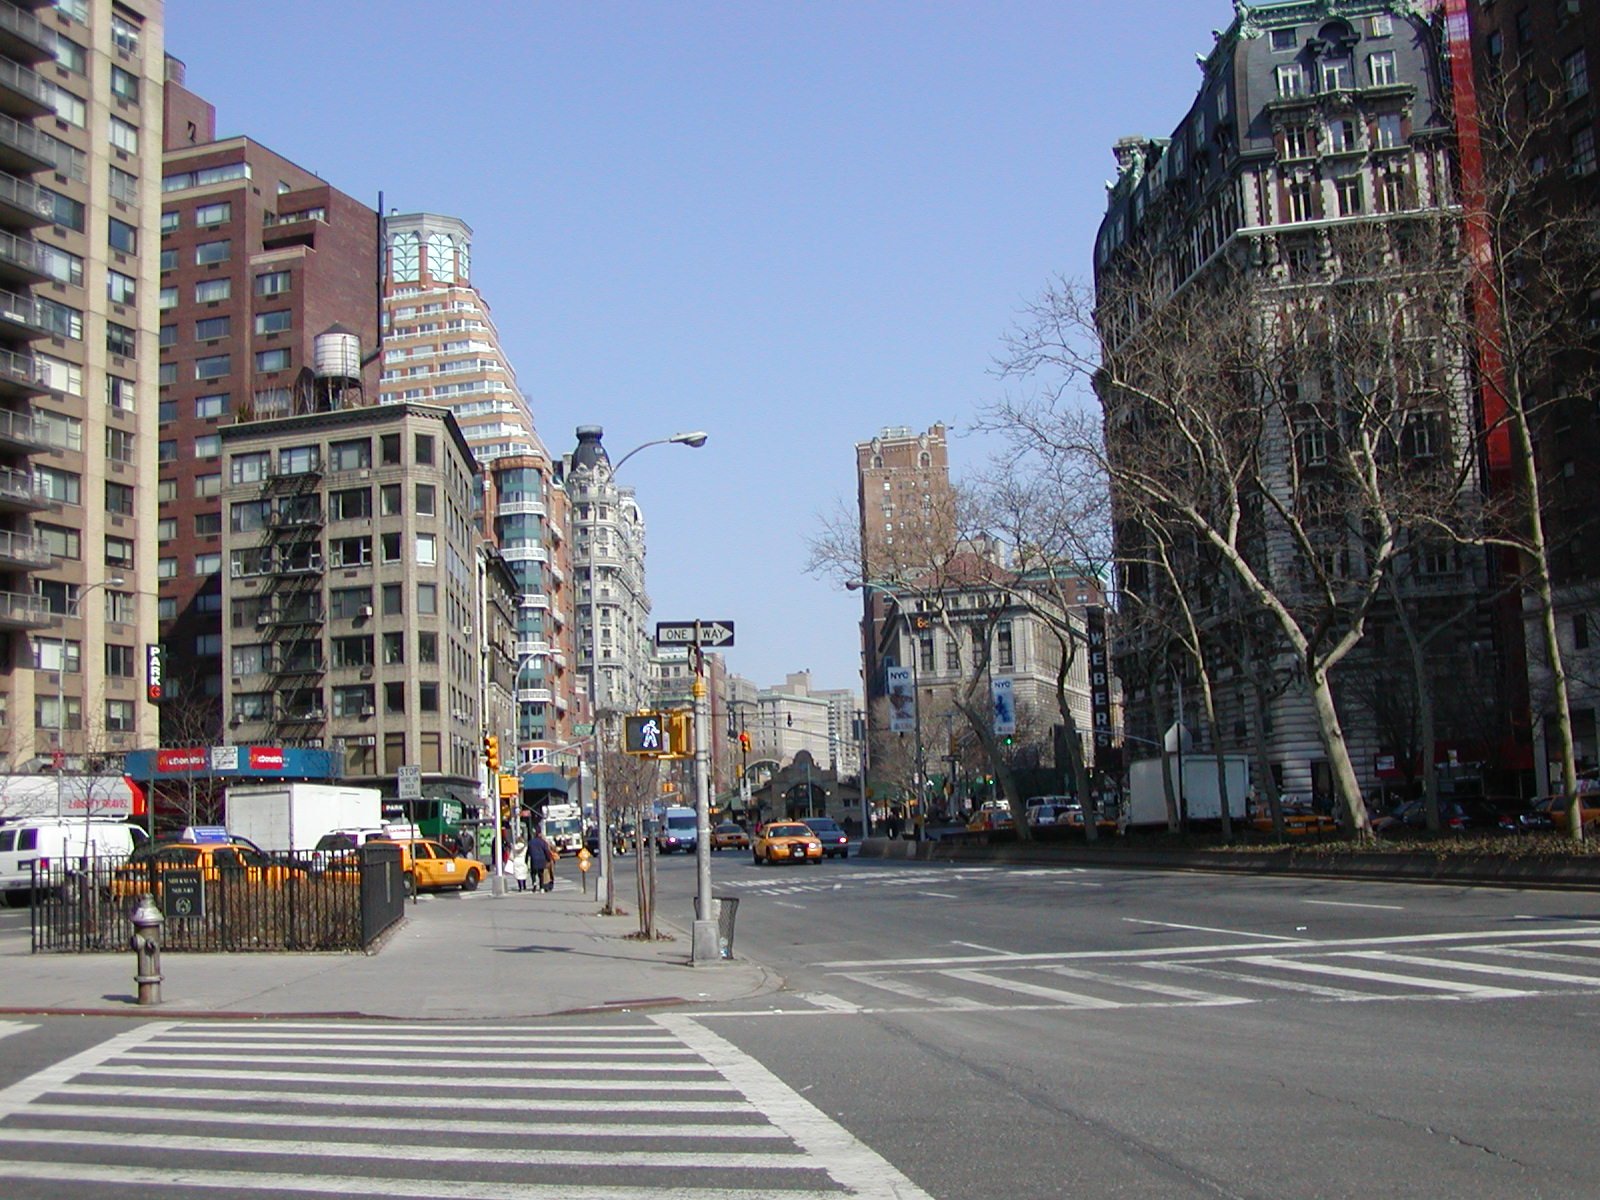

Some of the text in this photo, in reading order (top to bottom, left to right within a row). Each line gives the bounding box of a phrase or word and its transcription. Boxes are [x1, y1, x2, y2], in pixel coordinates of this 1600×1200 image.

[666, 629, 725, 640] ONE WAY
[150, 646, 161, 686] PARK
[890, 671, 909, 680] NYC
[1090, 632, 1108, 748] WEBER'S
[400, 767, 419, 776] STOP
